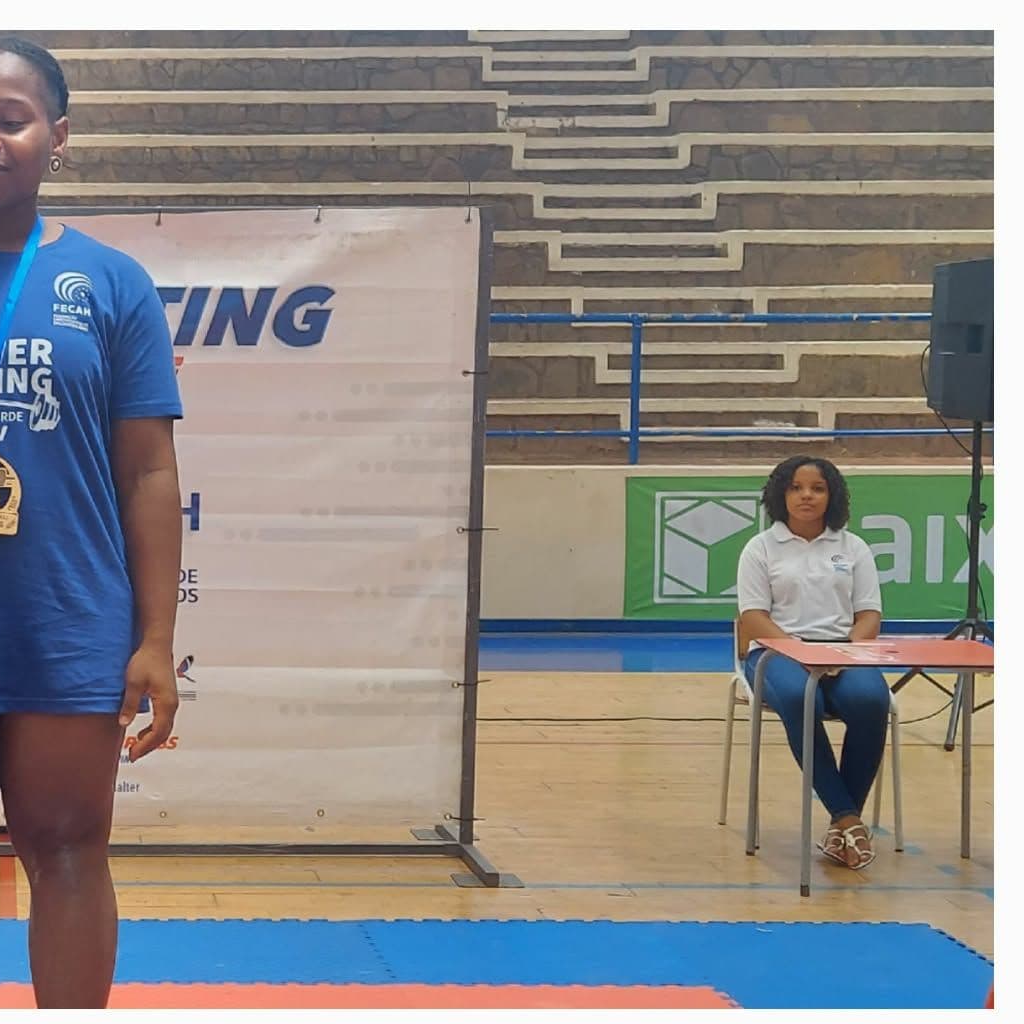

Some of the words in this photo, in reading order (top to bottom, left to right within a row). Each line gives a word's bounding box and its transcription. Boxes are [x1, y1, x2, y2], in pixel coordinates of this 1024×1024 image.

[53, 303, 91, 317] FECAH
[861, 514, 994, 584] aix
[116, 780, 140, 793] alter
